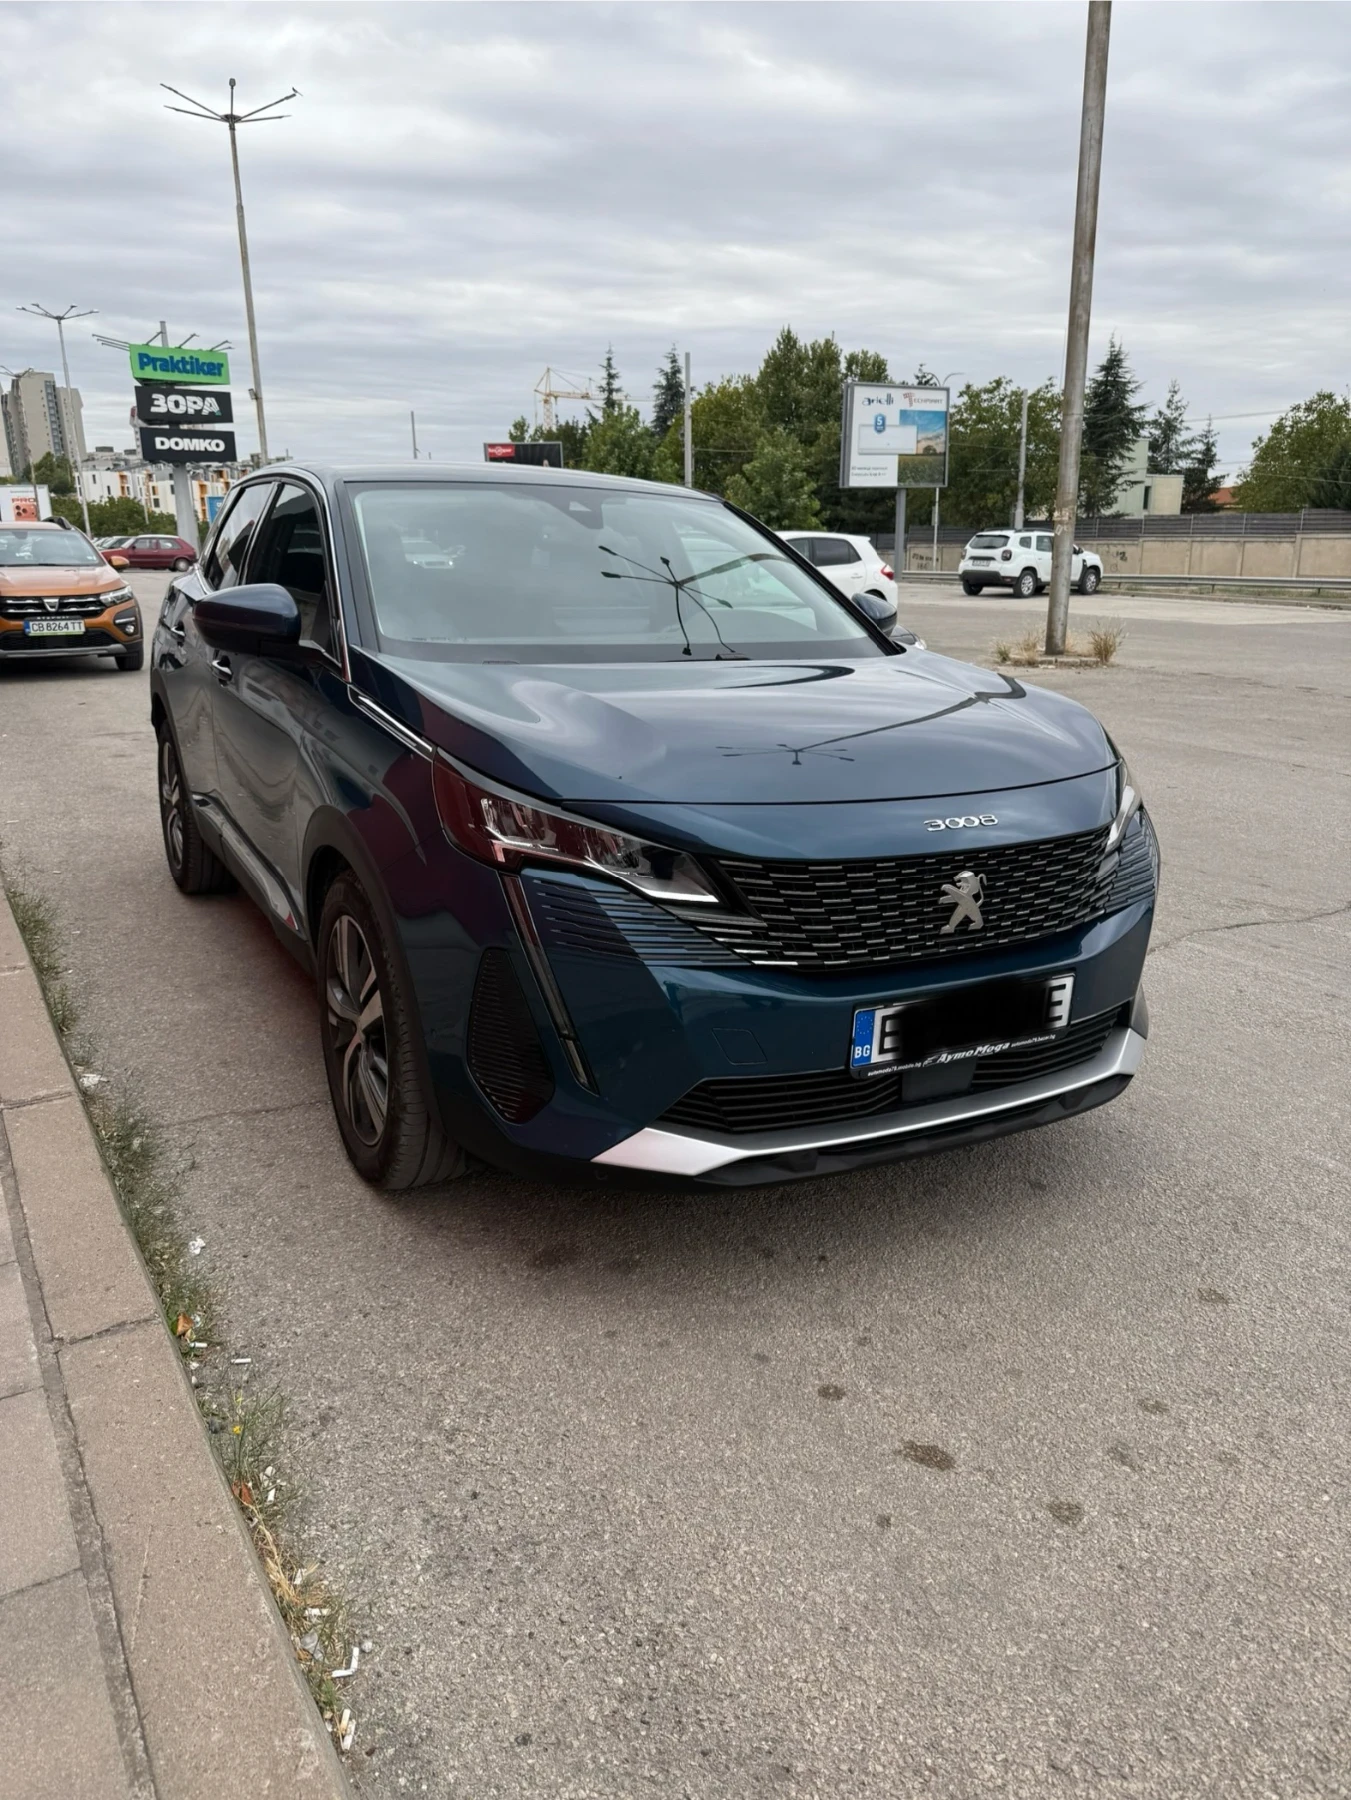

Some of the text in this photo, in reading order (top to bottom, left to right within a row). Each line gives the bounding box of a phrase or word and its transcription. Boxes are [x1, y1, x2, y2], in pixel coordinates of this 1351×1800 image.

[138, 352, 224, 376] Praktiker
[150, 393, 222, 416] ЗОРА
[861, 393, 894, 406] arielli
[876, 416, 883, 426] 5
[155, 436, 225, 452] DOMKO
[32, 622, 45, 632] CB
[46, 622, 69, 632] 8264
[70, 621, 83, 631] TT
[923, 814, 999, 832] 3008
[854, 1044, 871, 1059] BG
